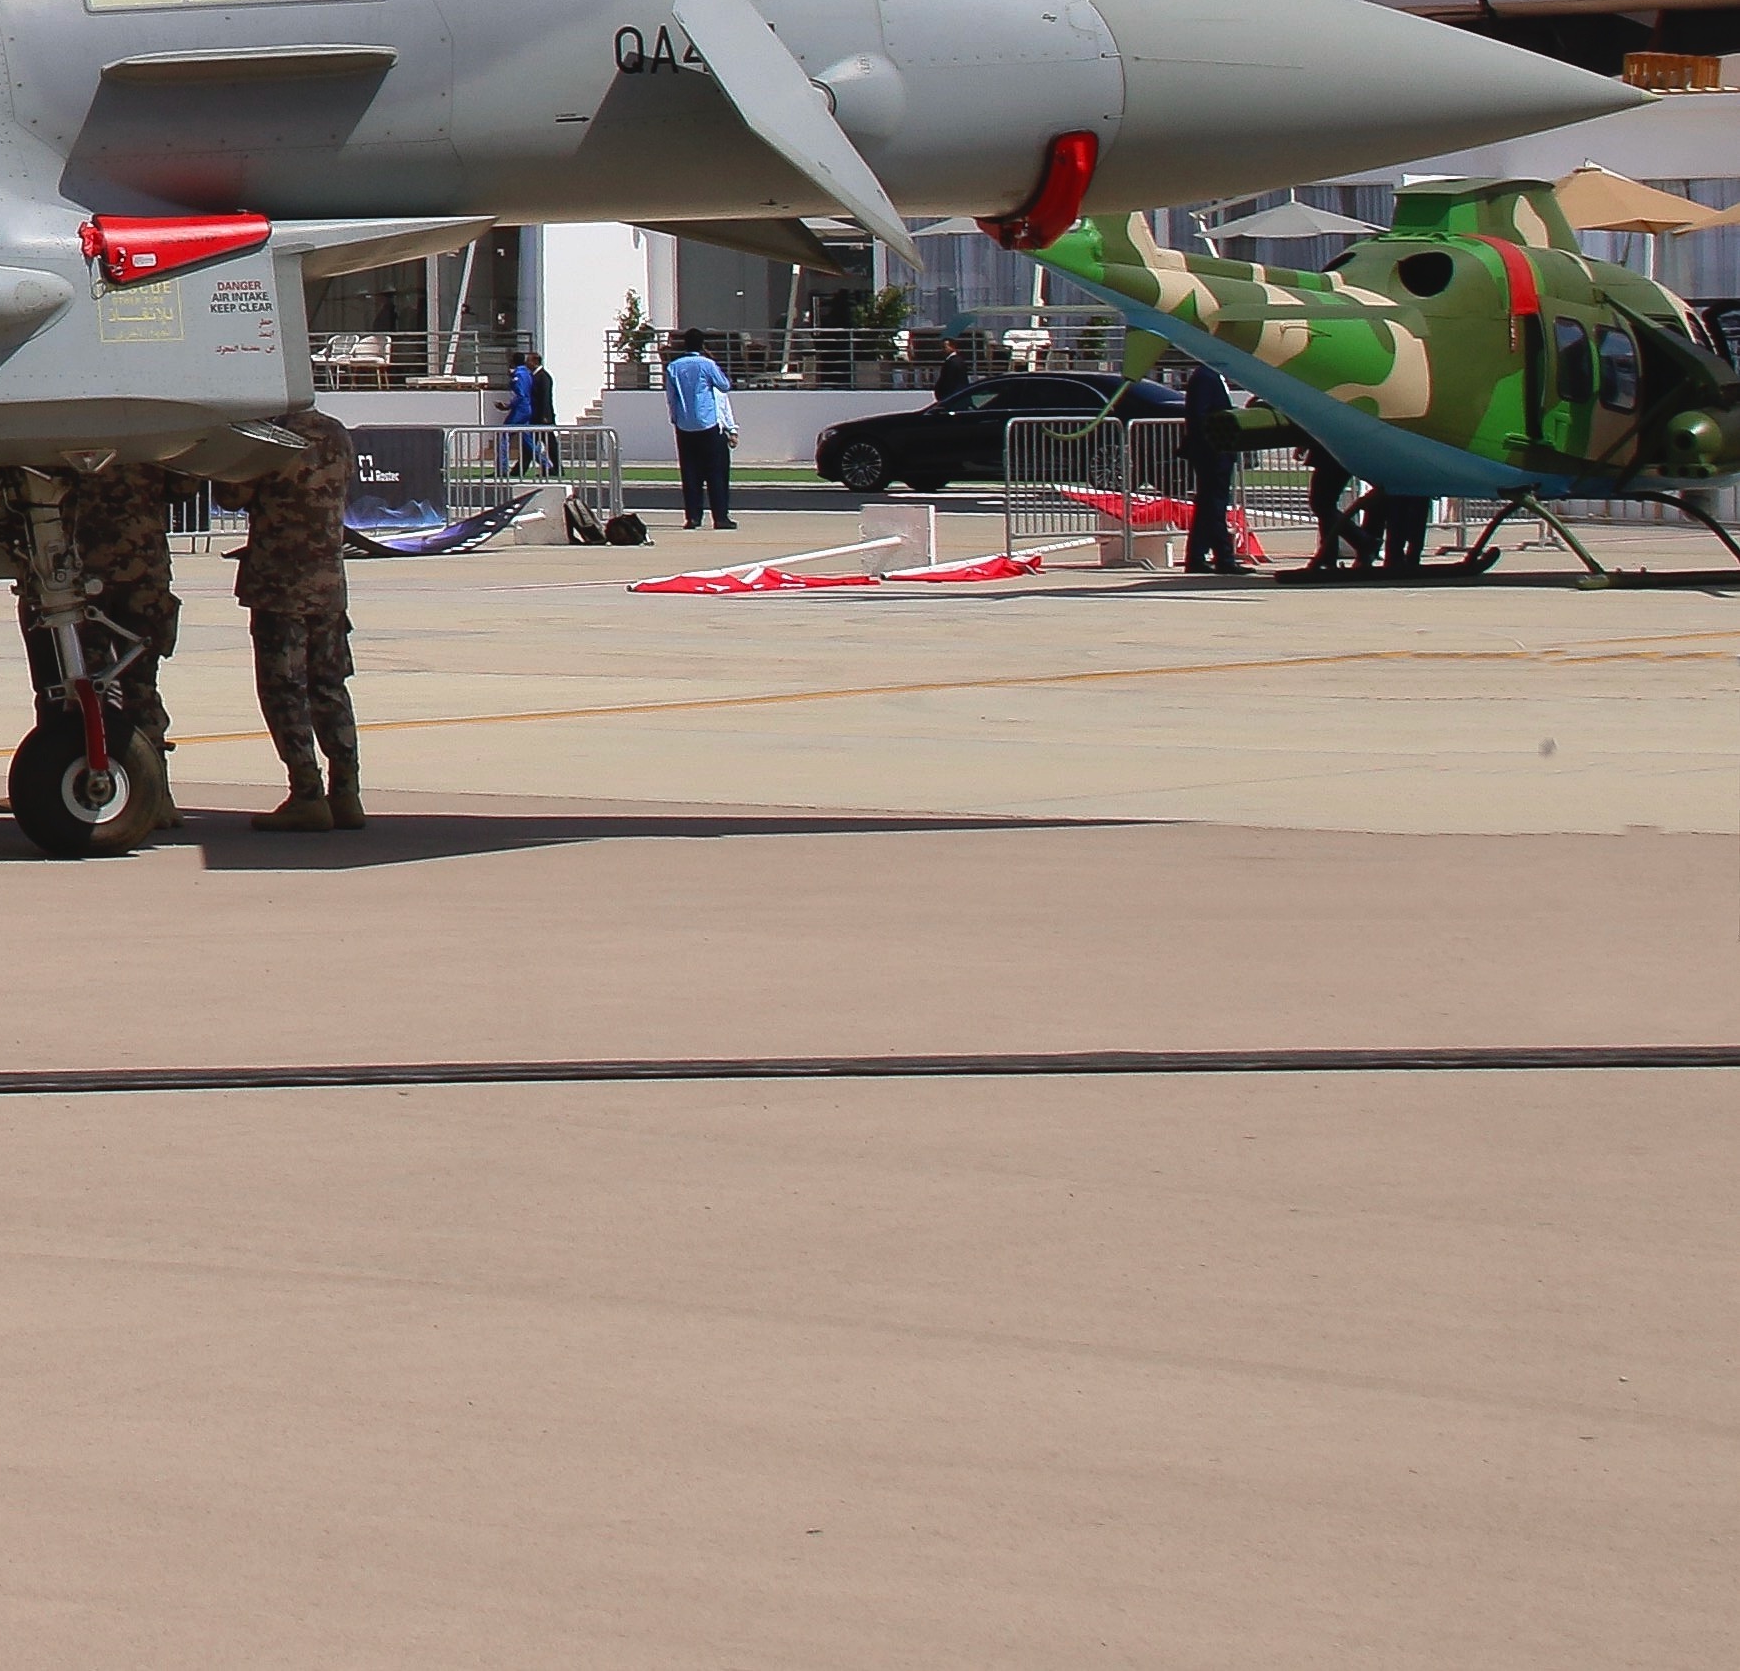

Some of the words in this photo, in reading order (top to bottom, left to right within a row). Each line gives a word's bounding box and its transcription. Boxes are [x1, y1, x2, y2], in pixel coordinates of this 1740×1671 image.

[217, 281, 262, 291] DANGER
[212, 293, 230, 302] AIR
[232, 292, 270, 302] INTAKE
[210, 303, 237, 313] KEEP
[238, 302, 273, 313] CLEAR
